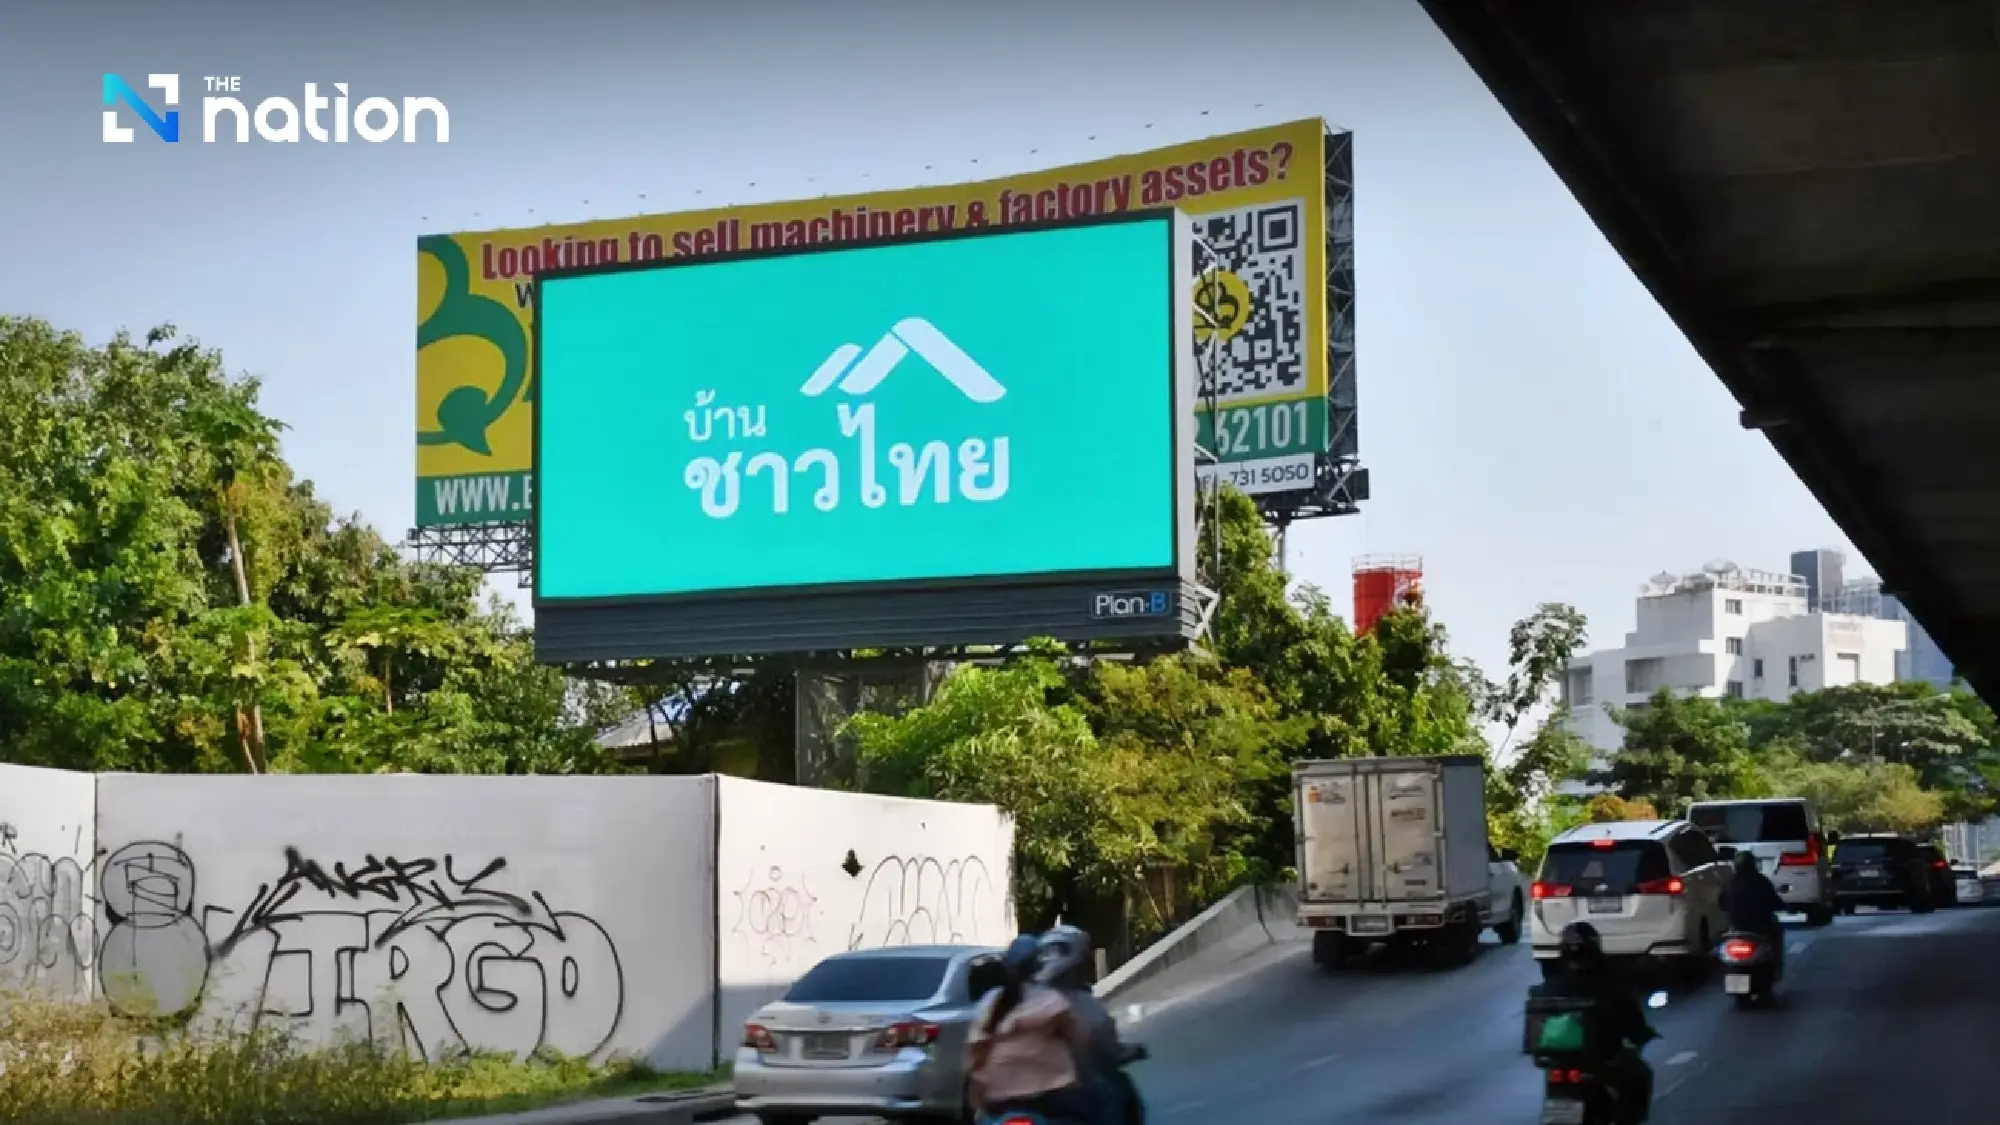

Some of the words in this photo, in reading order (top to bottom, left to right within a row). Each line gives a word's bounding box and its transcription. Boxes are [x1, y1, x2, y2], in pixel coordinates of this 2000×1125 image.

[629, 231, 663, 262] to
[672, 218, 739, 260] sell
[751, 204, 956, 249] machinery
[999, 174, 1131, 227] factory
[1141, 142, 1293, 205] assets?
[683, 389, 767, 441] บ้าน
[683, 402, 1009, 519] ชาวไทย
[1261, 463, 1309, 483] 5050
